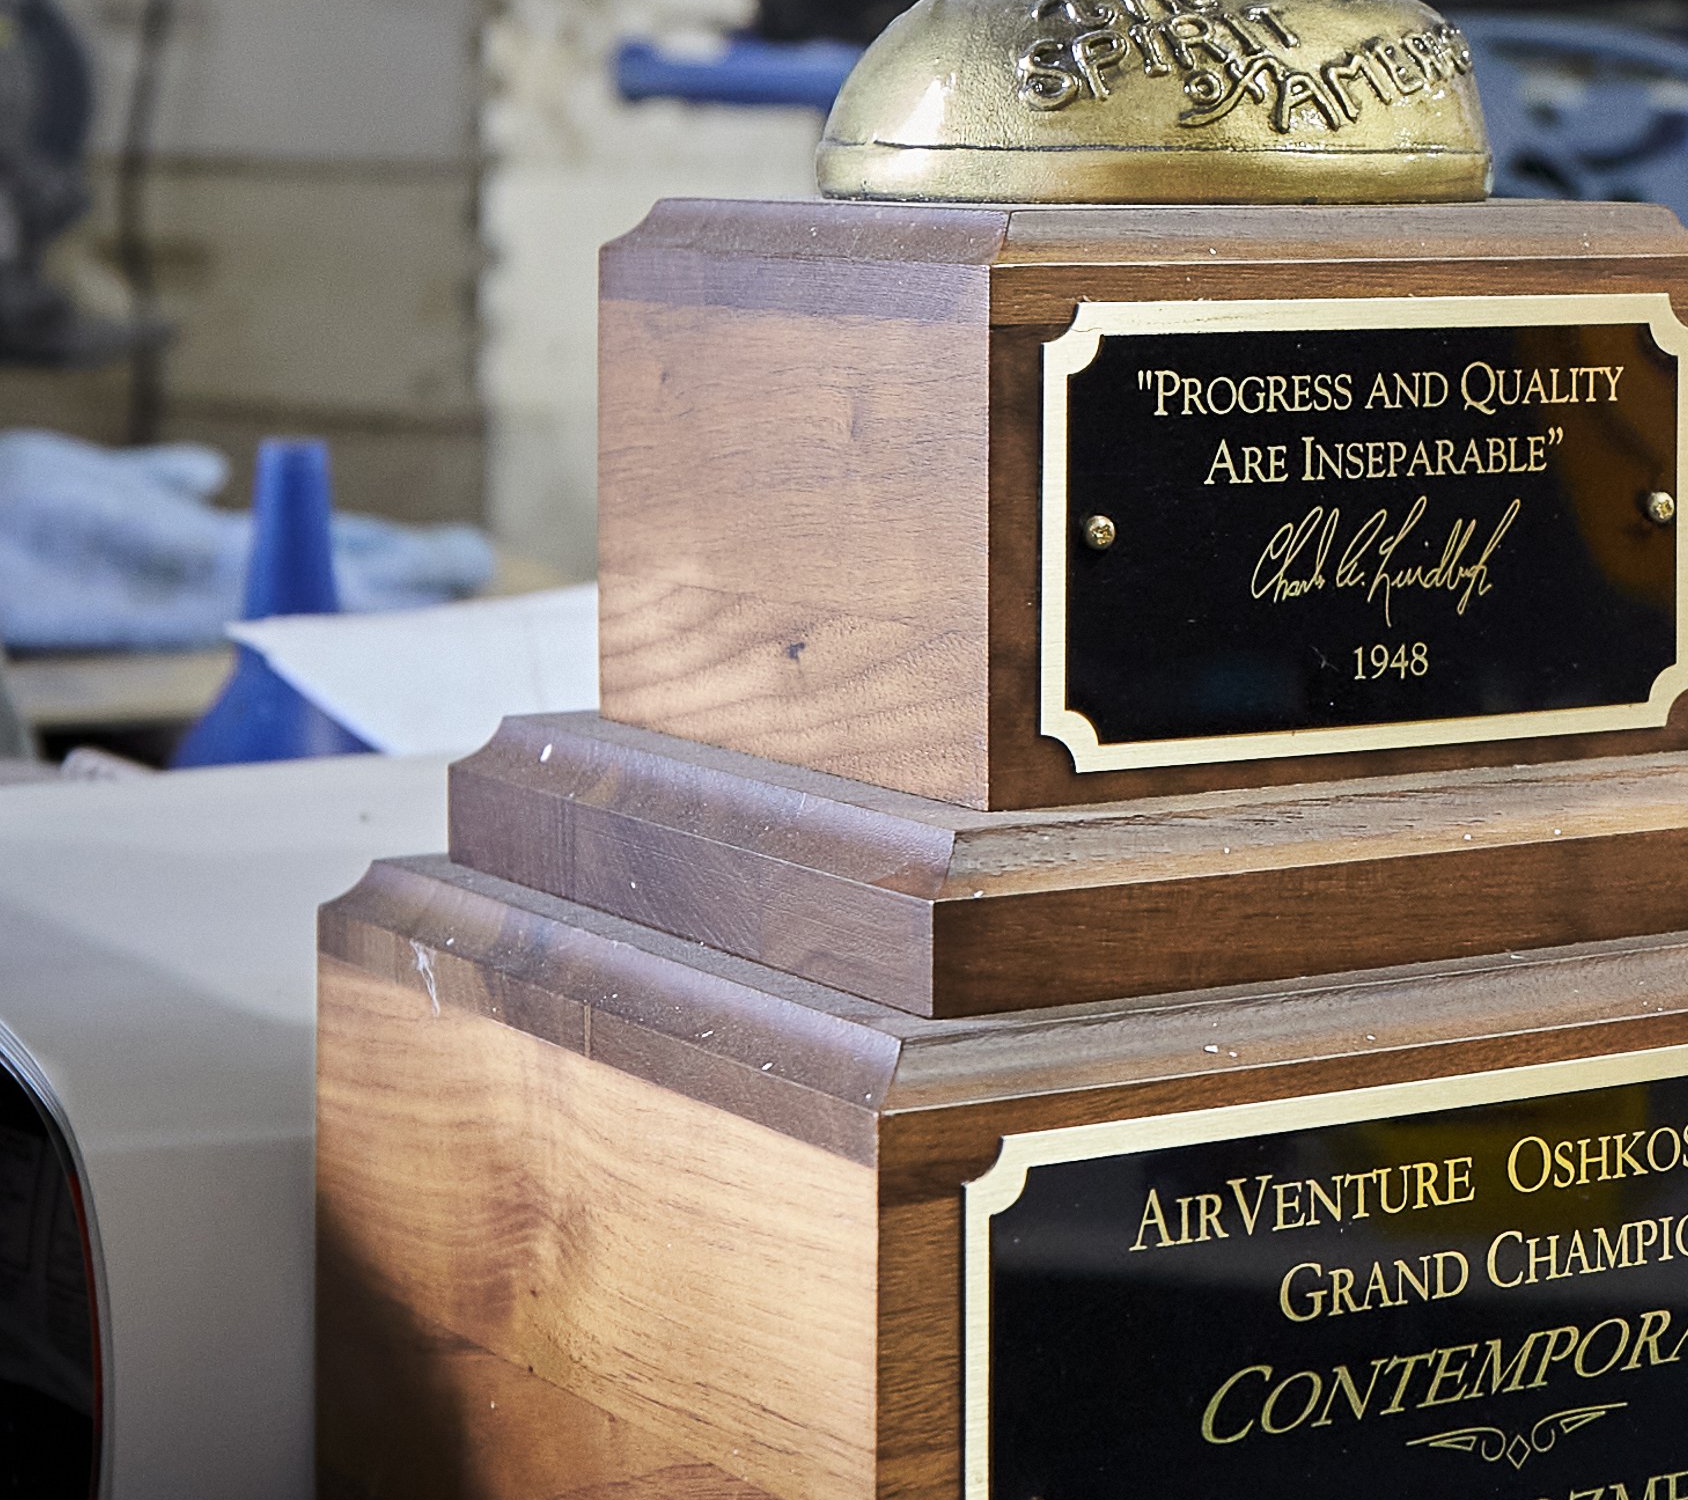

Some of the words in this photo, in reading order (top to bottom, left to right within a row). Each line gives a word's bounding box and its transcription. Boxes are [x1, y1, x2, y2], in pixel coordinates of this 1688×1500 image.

[1017, 3, 1300, 111] SPIRIT
[1365, 372, 1448, 409] AND
[1461, 362, 1624, 414] QUALITY
[1204, 439, 1288, 484] ARE
[1355, 643, 1429, 680] 1948
[1280, 1251, 1468, 1321] GRAND
